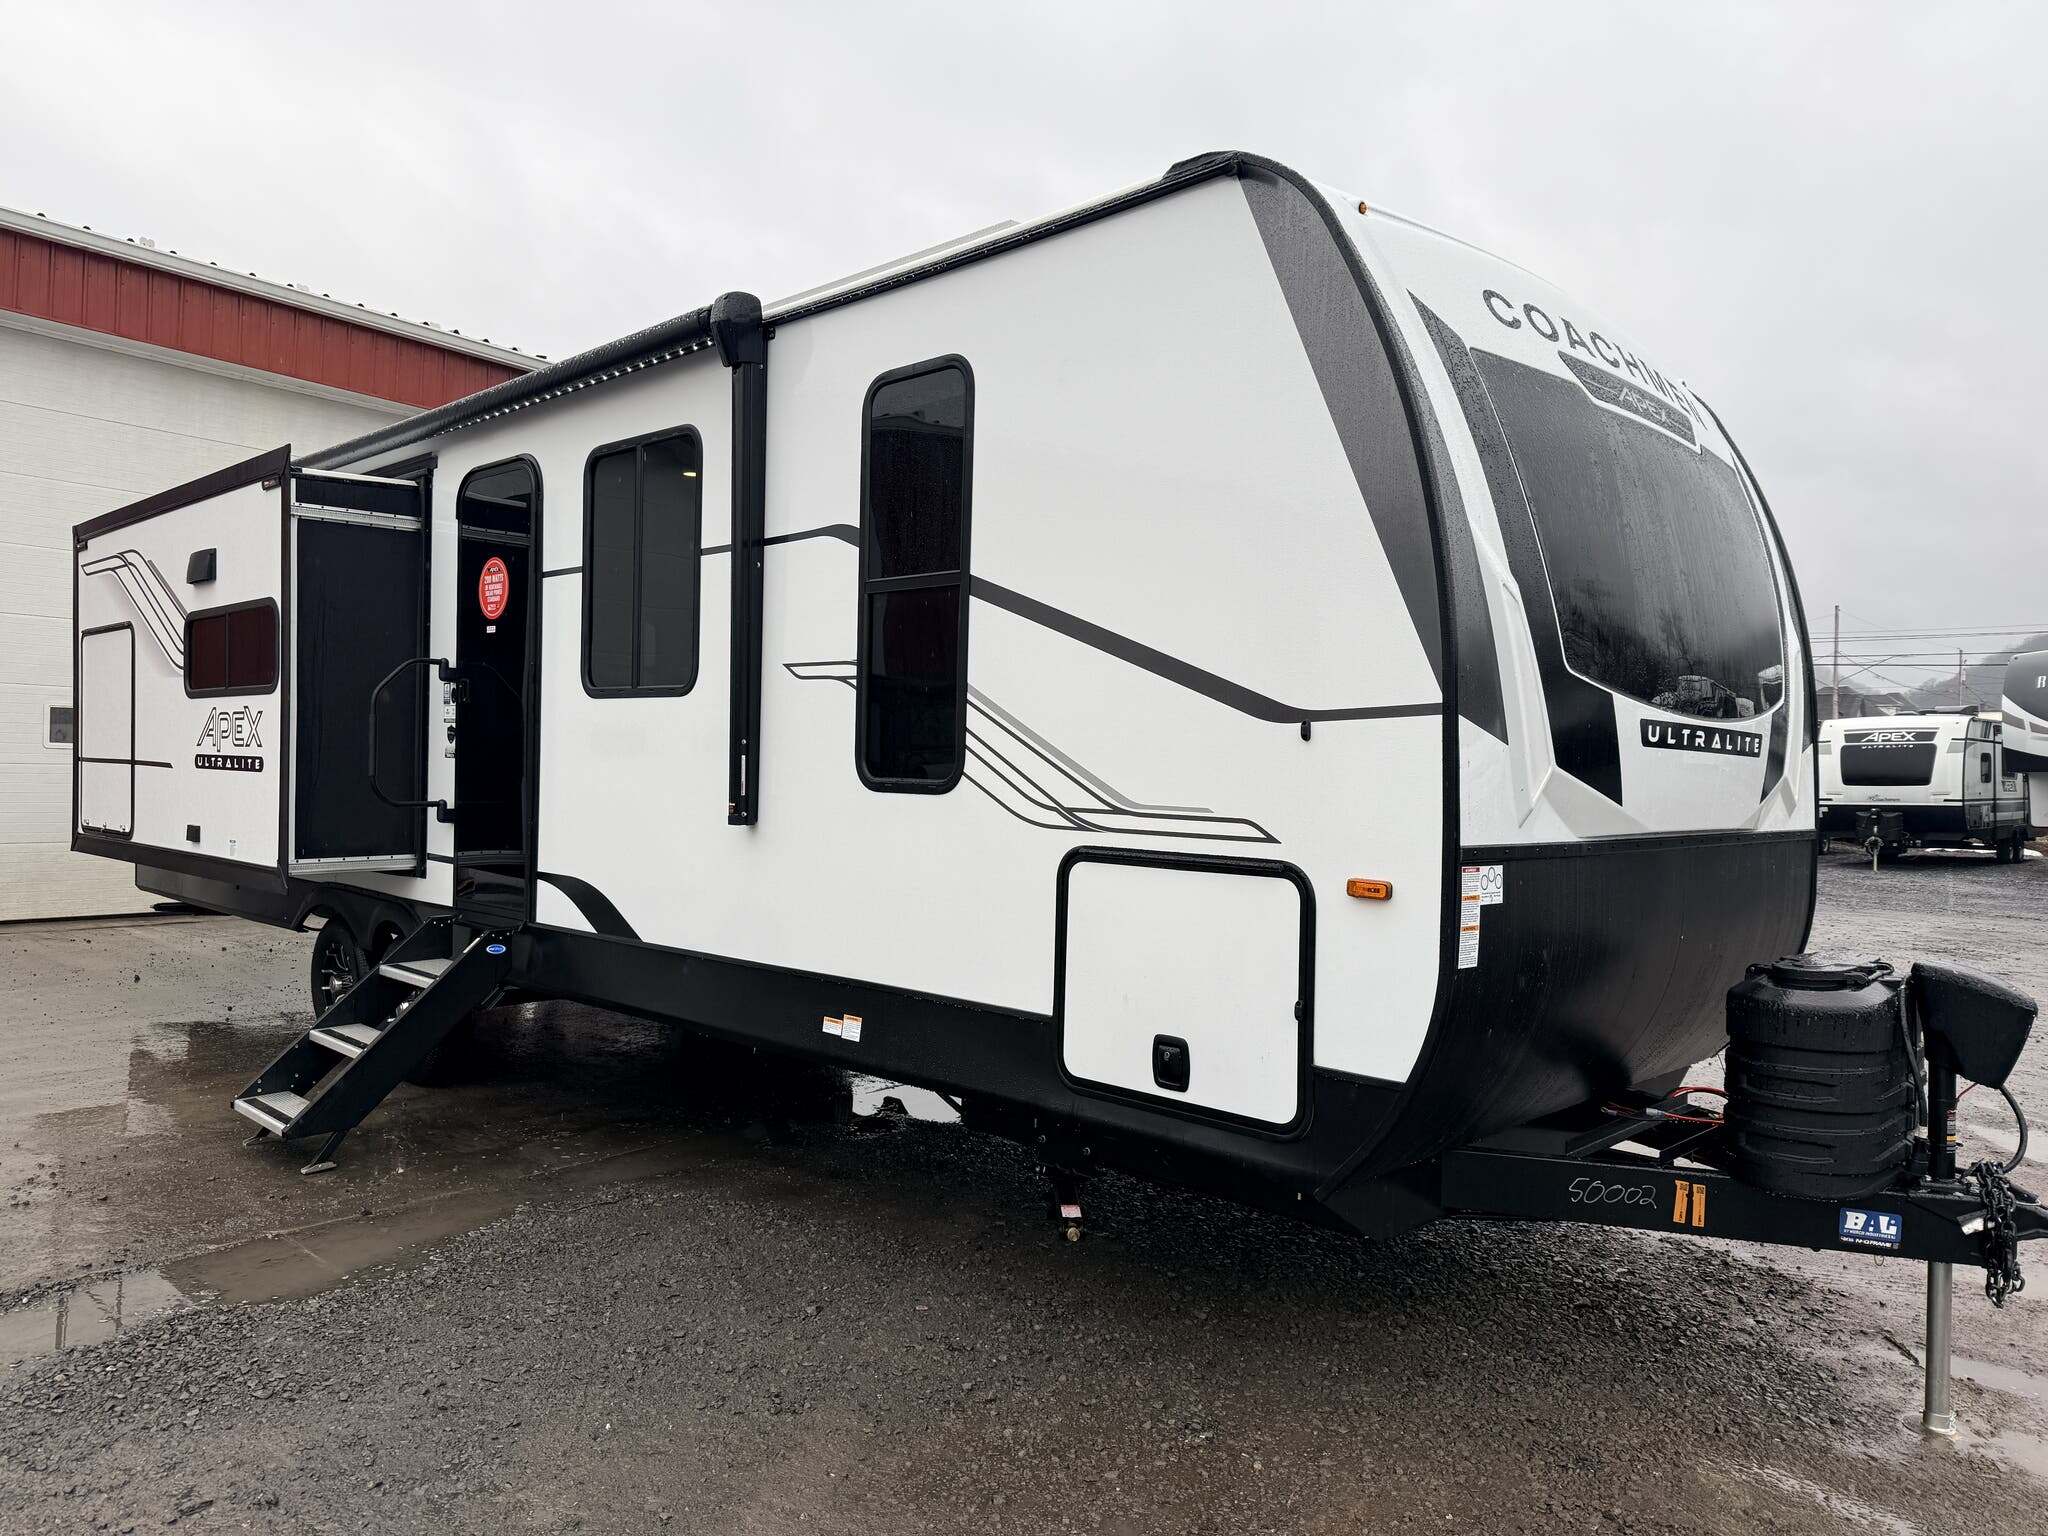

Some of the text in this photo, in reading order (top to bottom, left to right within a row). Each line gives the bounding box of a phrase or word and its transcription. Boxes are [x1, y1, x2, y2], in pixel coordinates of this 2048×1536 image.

[1618, 386, 1675, 427] APEX
[196, 705, 263, 753] APEX
[1647, 724, 1761, 753] ULTRALITE
[1861, 731, 1917, 742] APEX
[197, 756, 261, 770] ULTRALITE
[1568, 1177, 1658, 1209] 50002
